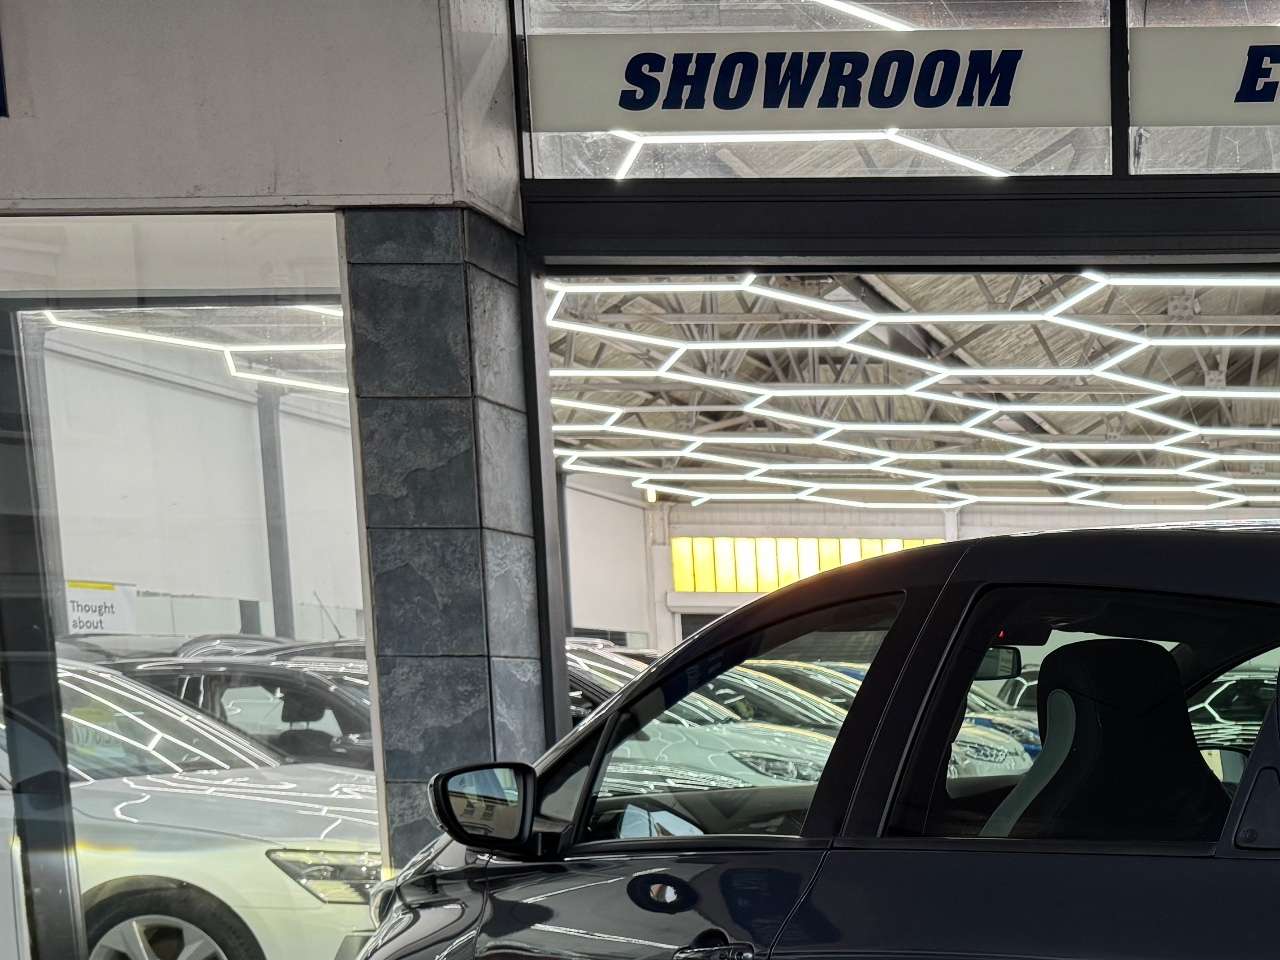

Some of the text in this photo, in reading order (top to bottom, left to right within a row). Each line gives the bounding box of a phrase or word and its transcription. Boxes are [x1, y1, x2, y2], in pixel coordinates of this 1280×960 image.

[618, 49, 1024, 111] SHOWROOM
[69, 600, 116, 617] Thought
[72, 616, 105, 631] about
